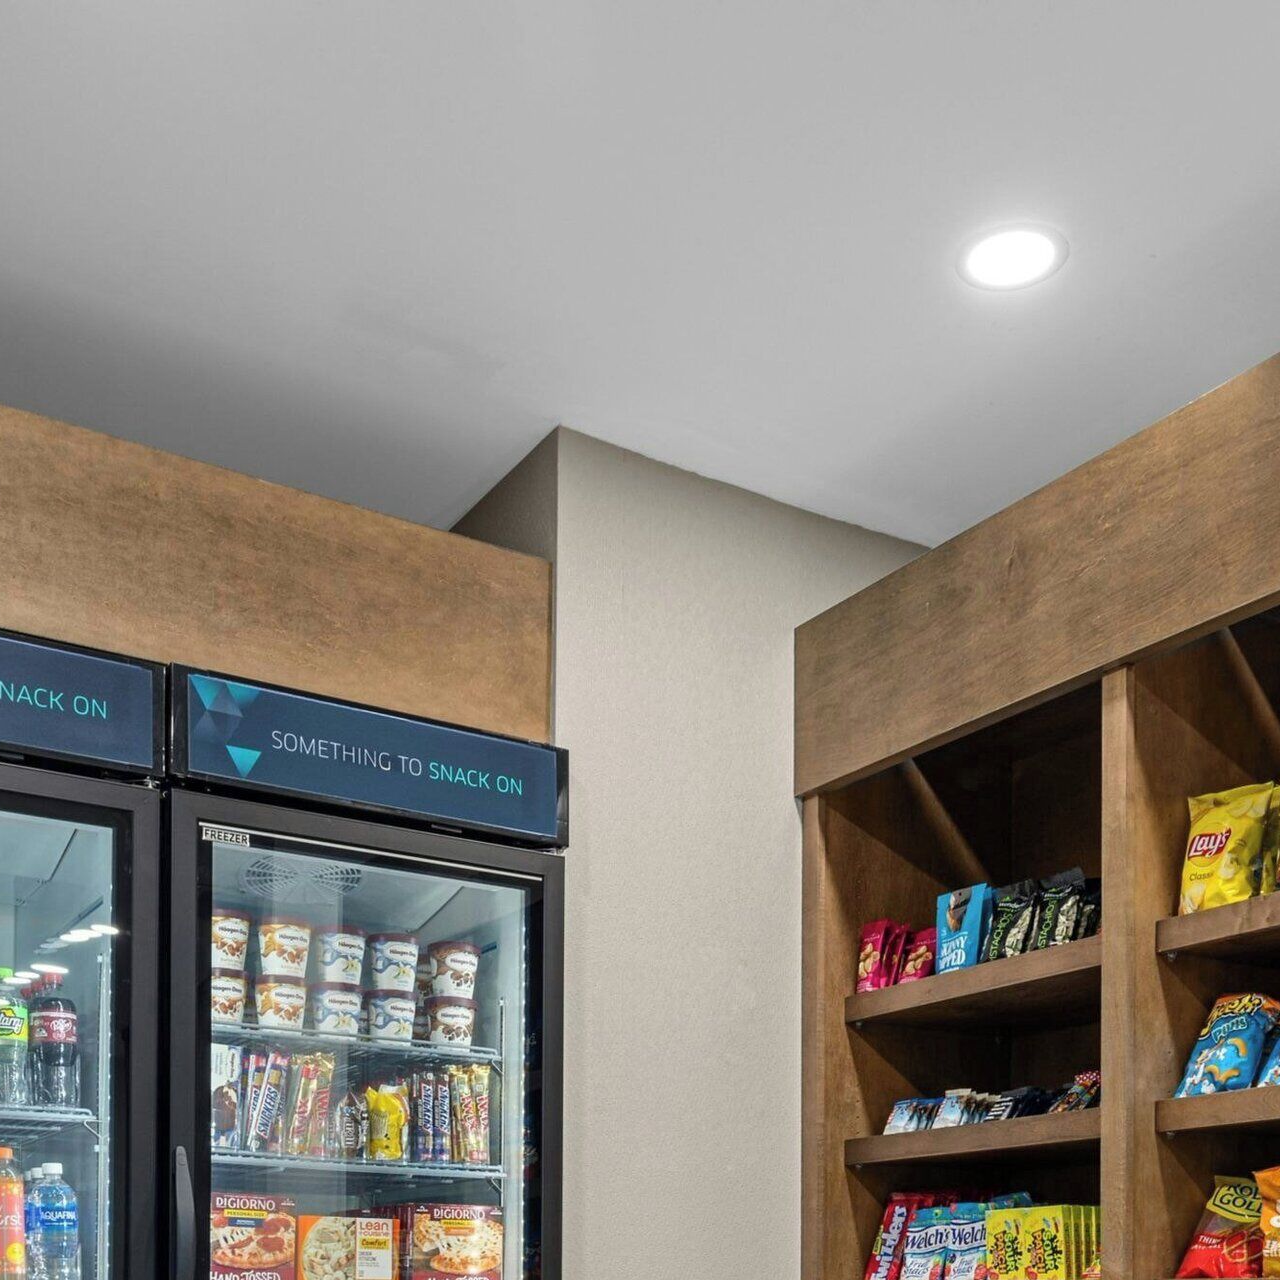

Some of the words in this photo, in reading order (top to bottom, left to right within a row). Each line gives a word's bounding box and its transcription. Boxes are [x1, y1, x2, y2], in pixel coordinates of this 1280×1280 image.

[73, 695, 108, 720] ON
[271, 730, 391, 771] SOMETHING
[398, 755, 422, 777] TO
[429, 762, 489, 790] SNACK
[496, 775, 522, 796] ON
[203, 827, 249, 845] FREEZER
[1188, 826, 1232, 857] Lay's
[257, 1084, 279, 1140] SNICKERS
[422, 1083, 433, 1134] SNICKERS
[41, 1210, 77, 1220] AQUAFINA
[359, 1221, 389, 1231] Lean
[906, 1228, 950, 1250] Welch's
[993, 1229, 1007, 1274] PATCH
[1031, 1229, 1046, 1273] PATCH
[1042, 1229, 1057, 1270] SOUR
